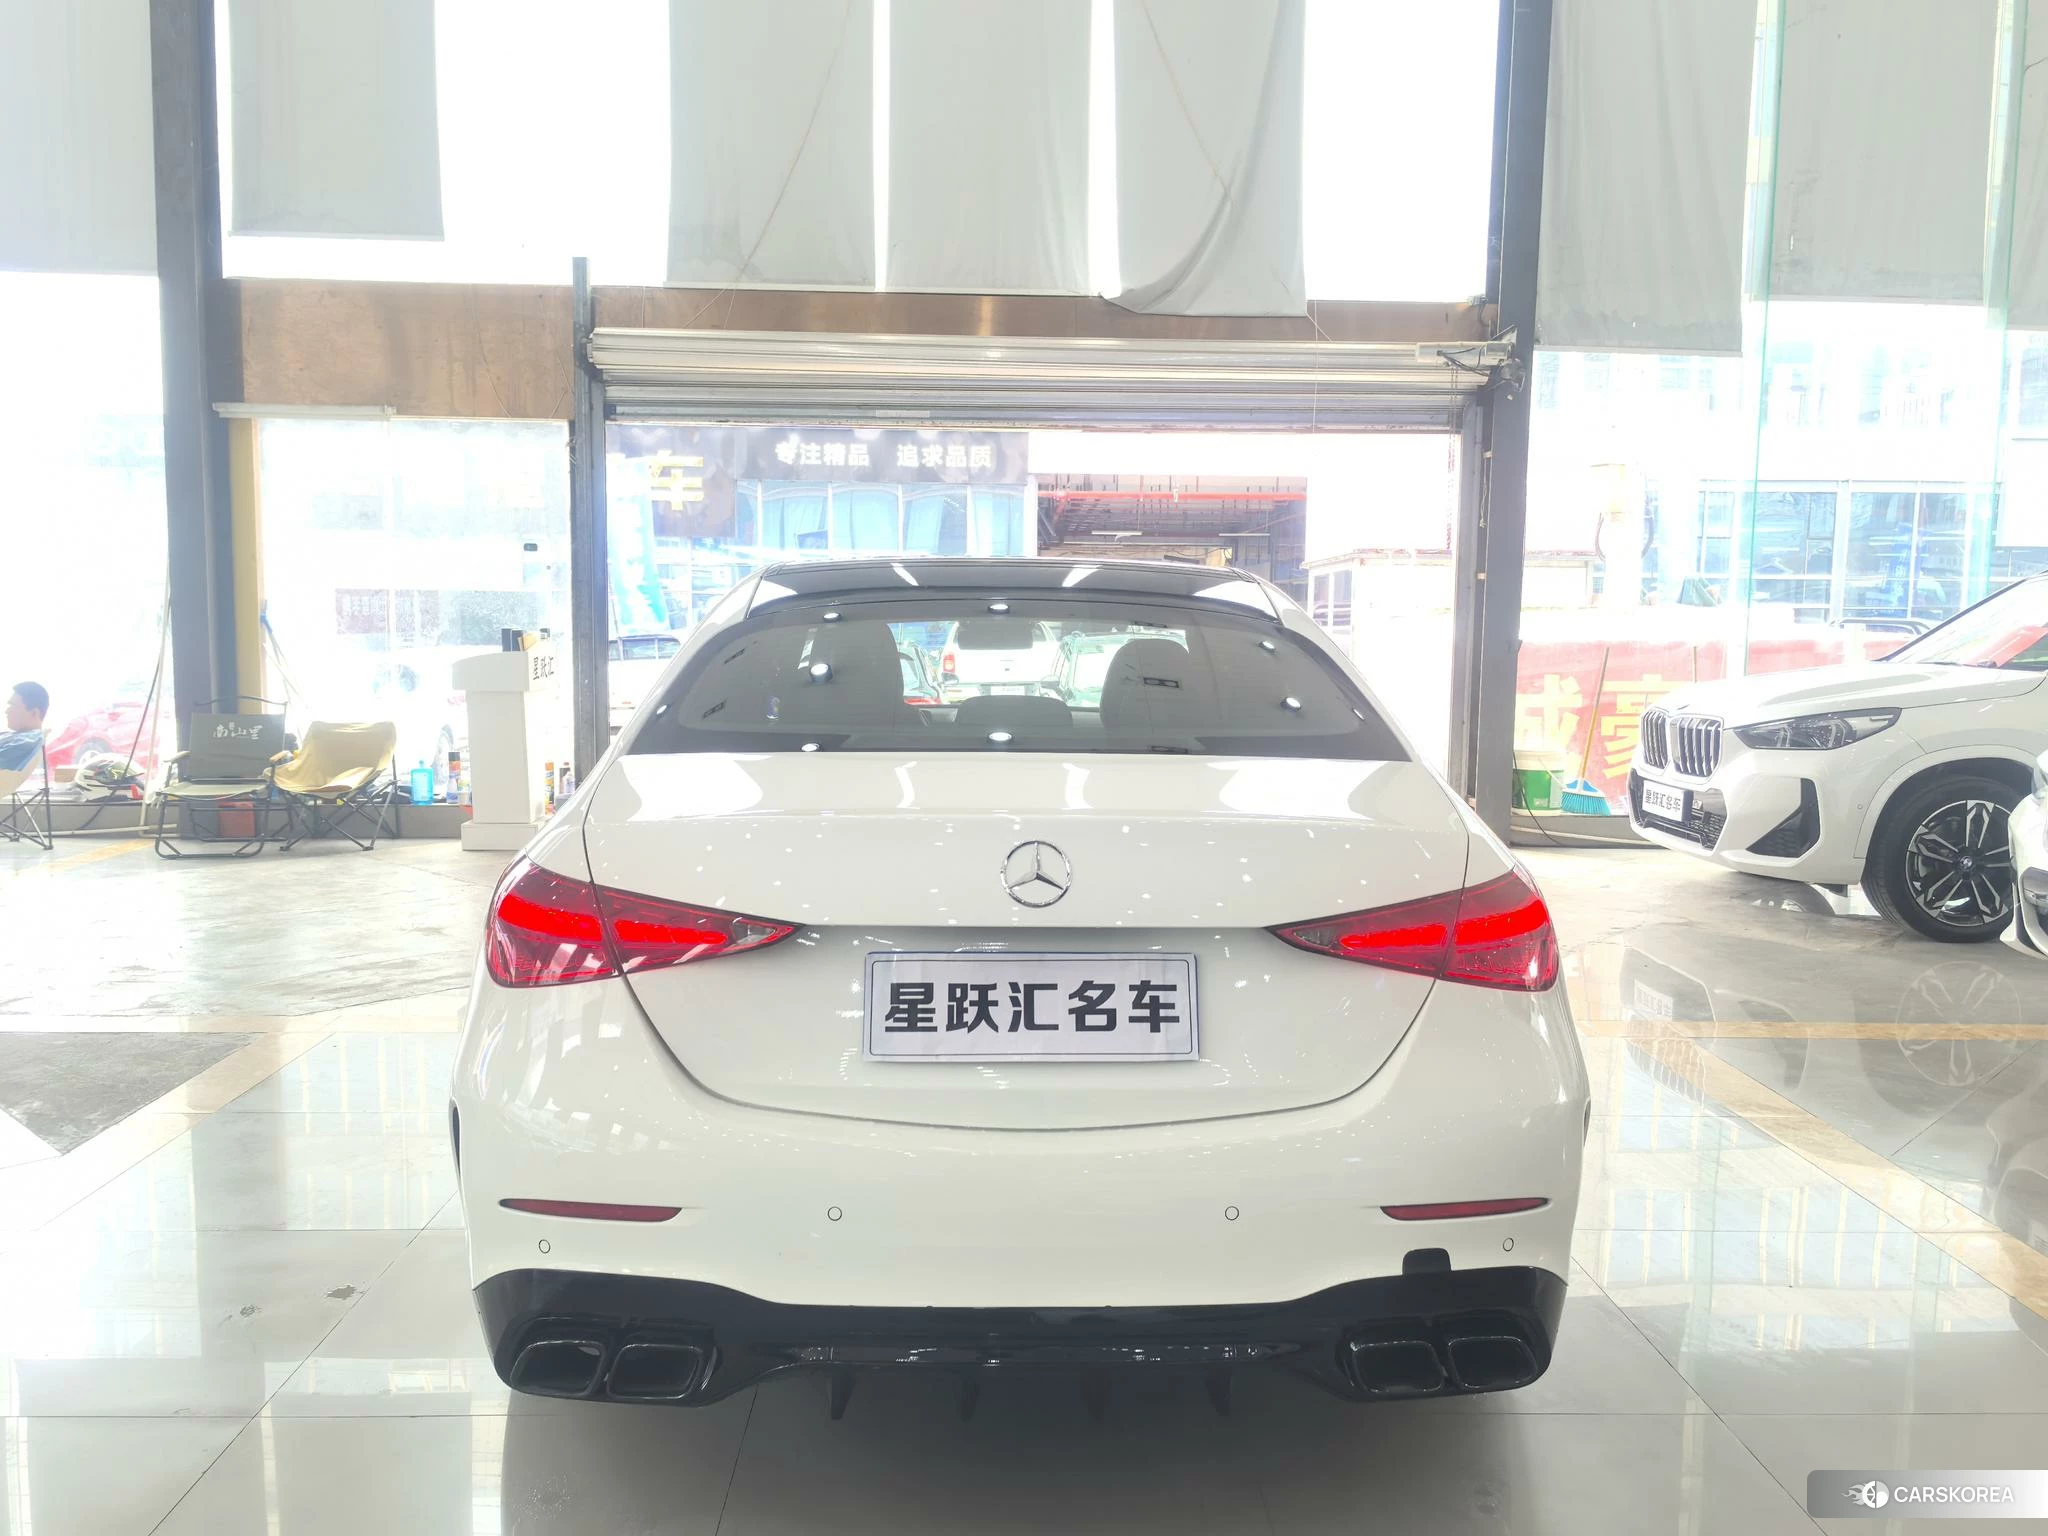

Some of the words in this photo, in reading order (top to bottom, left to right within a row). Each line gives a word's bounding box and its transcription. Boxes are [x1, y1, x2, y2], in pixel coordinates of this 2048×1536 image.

[775, 442, 870, 467] 专注精品
[897, 444, 993, 468] 追求品质
[1645, 789, 1681, 813] 星跃汇名车
[884, 979, 1181, 1034] 星跃汇名车
